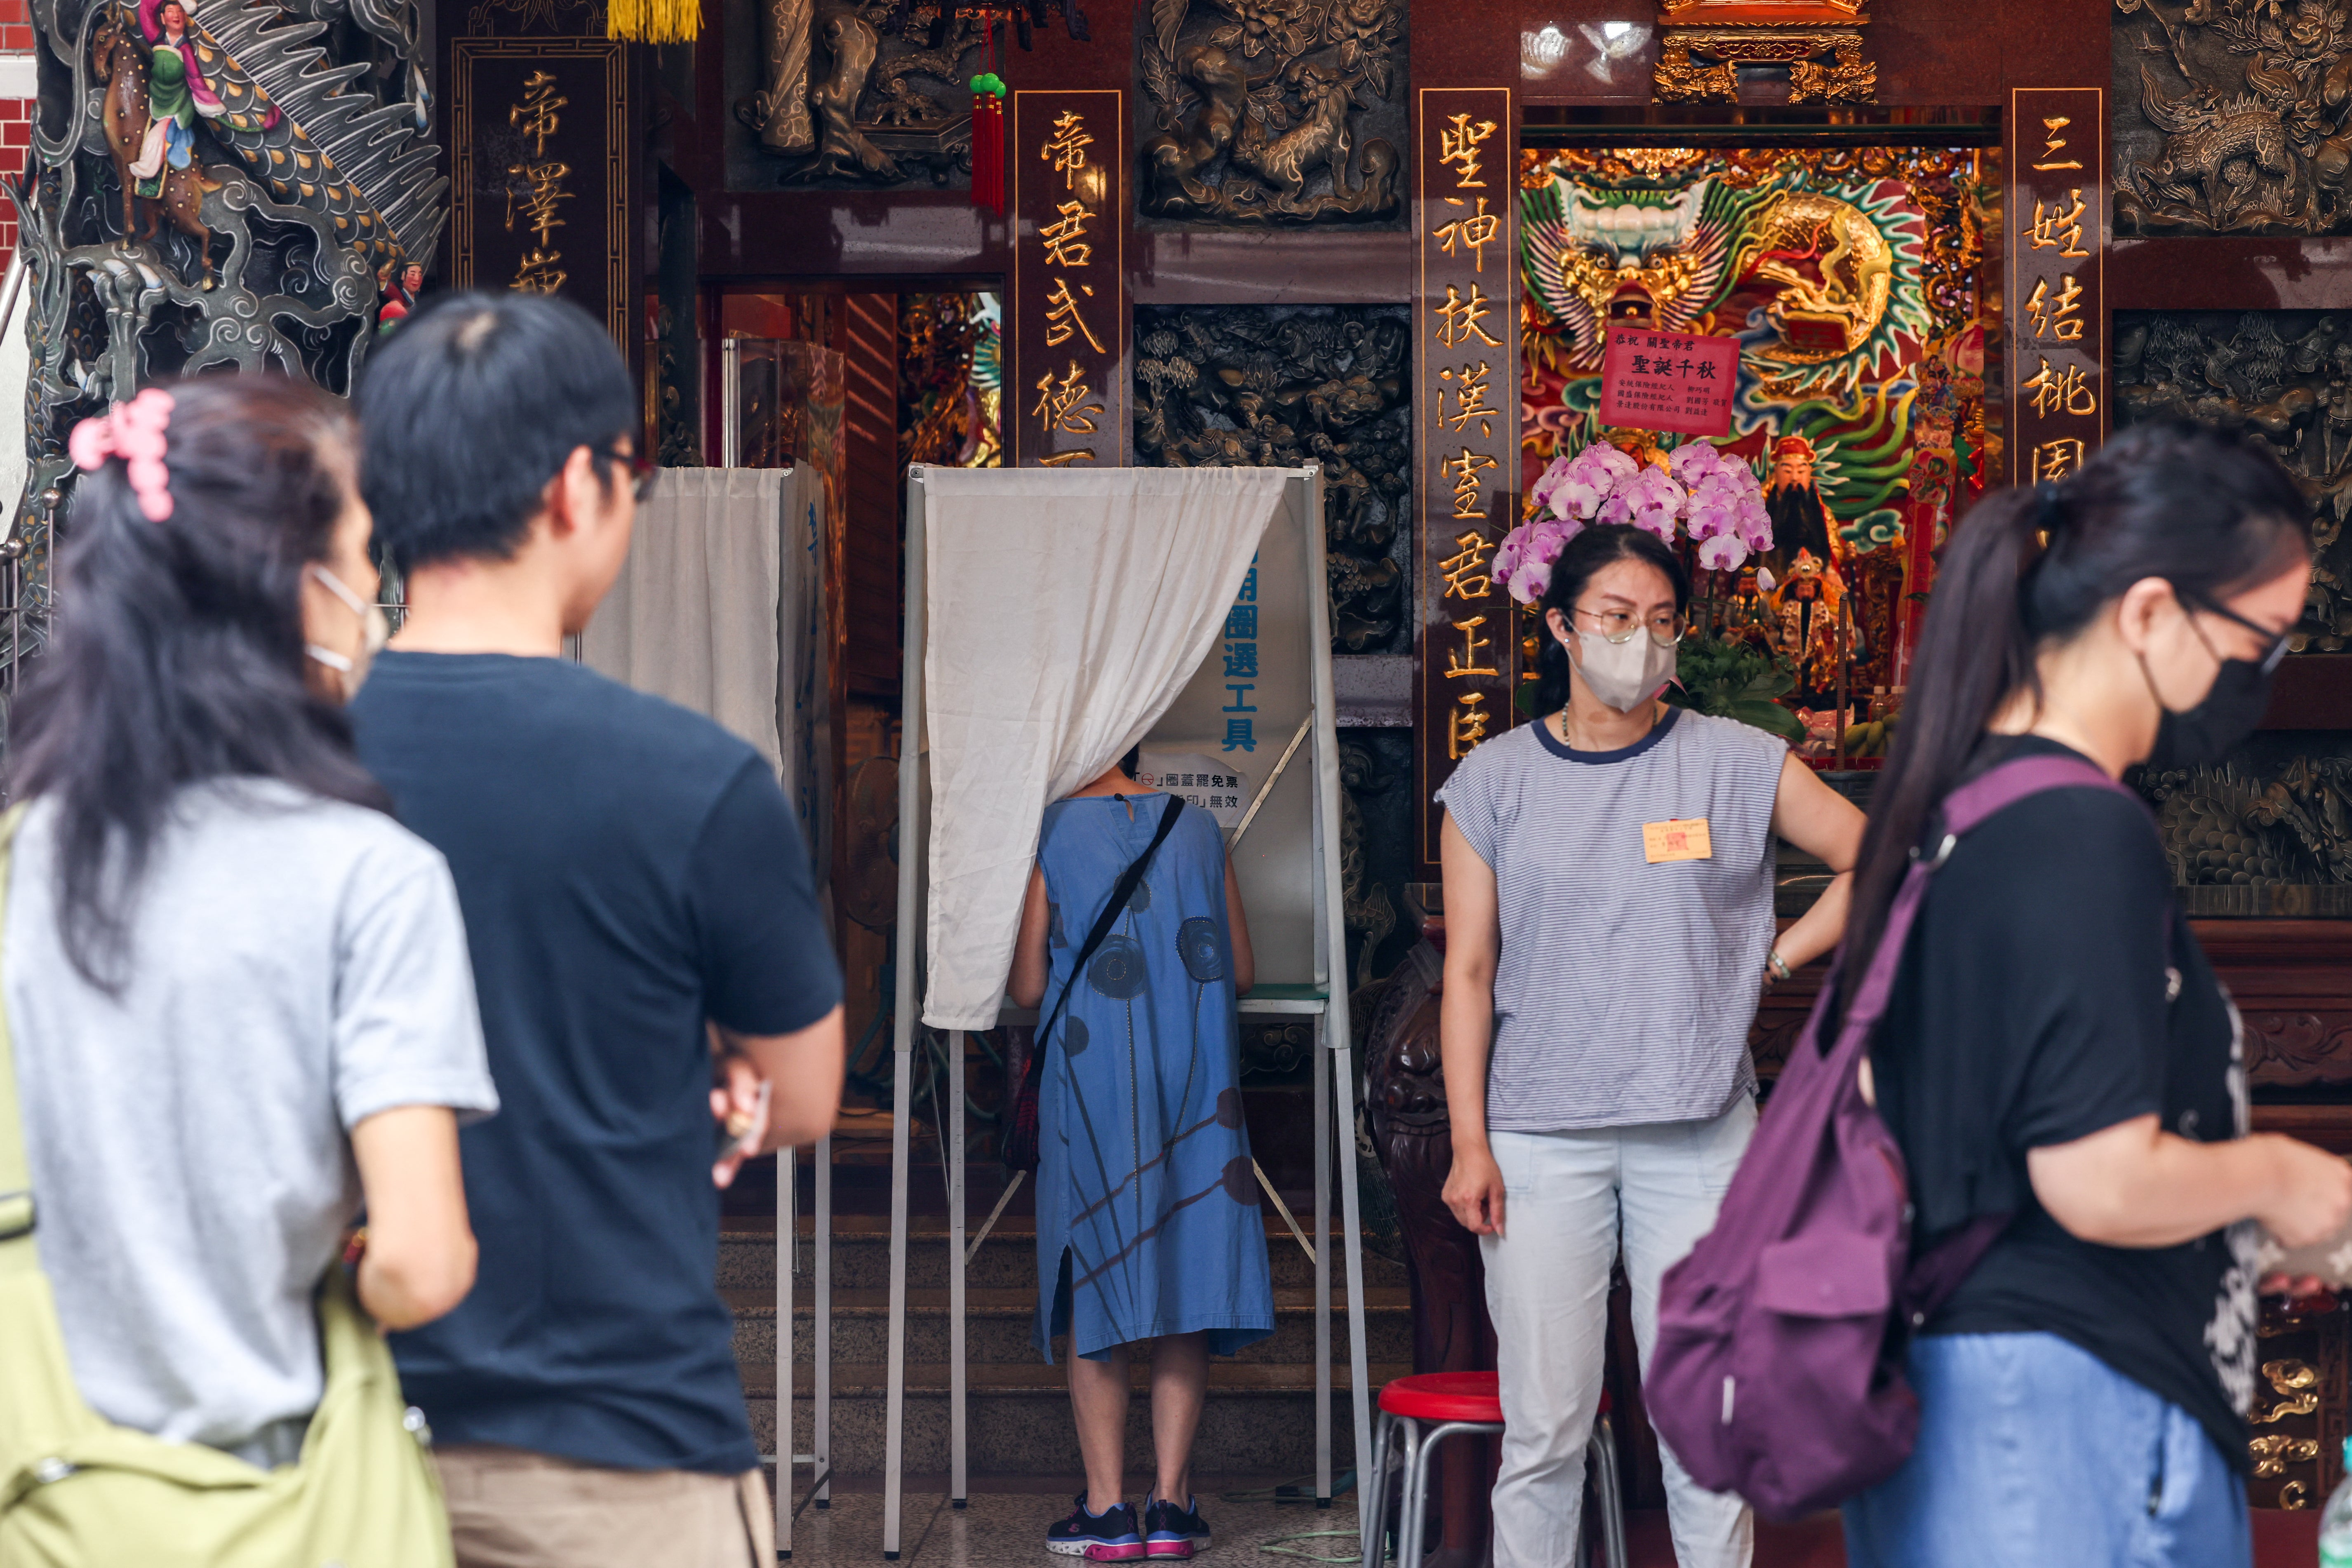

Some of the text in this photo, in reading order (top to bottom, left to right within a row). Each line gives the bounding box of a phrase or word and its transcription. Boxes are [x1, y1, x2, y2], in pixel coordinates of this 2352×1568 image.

[1032, 110, 1106, 467] 帝君武德
[1615, 334, 1695, 351] 恭祝 關聖帝君
[1631, 355, 1716, 379] 聖誕千秋
[1221, 549, 1258, 752] 用圈選工具
